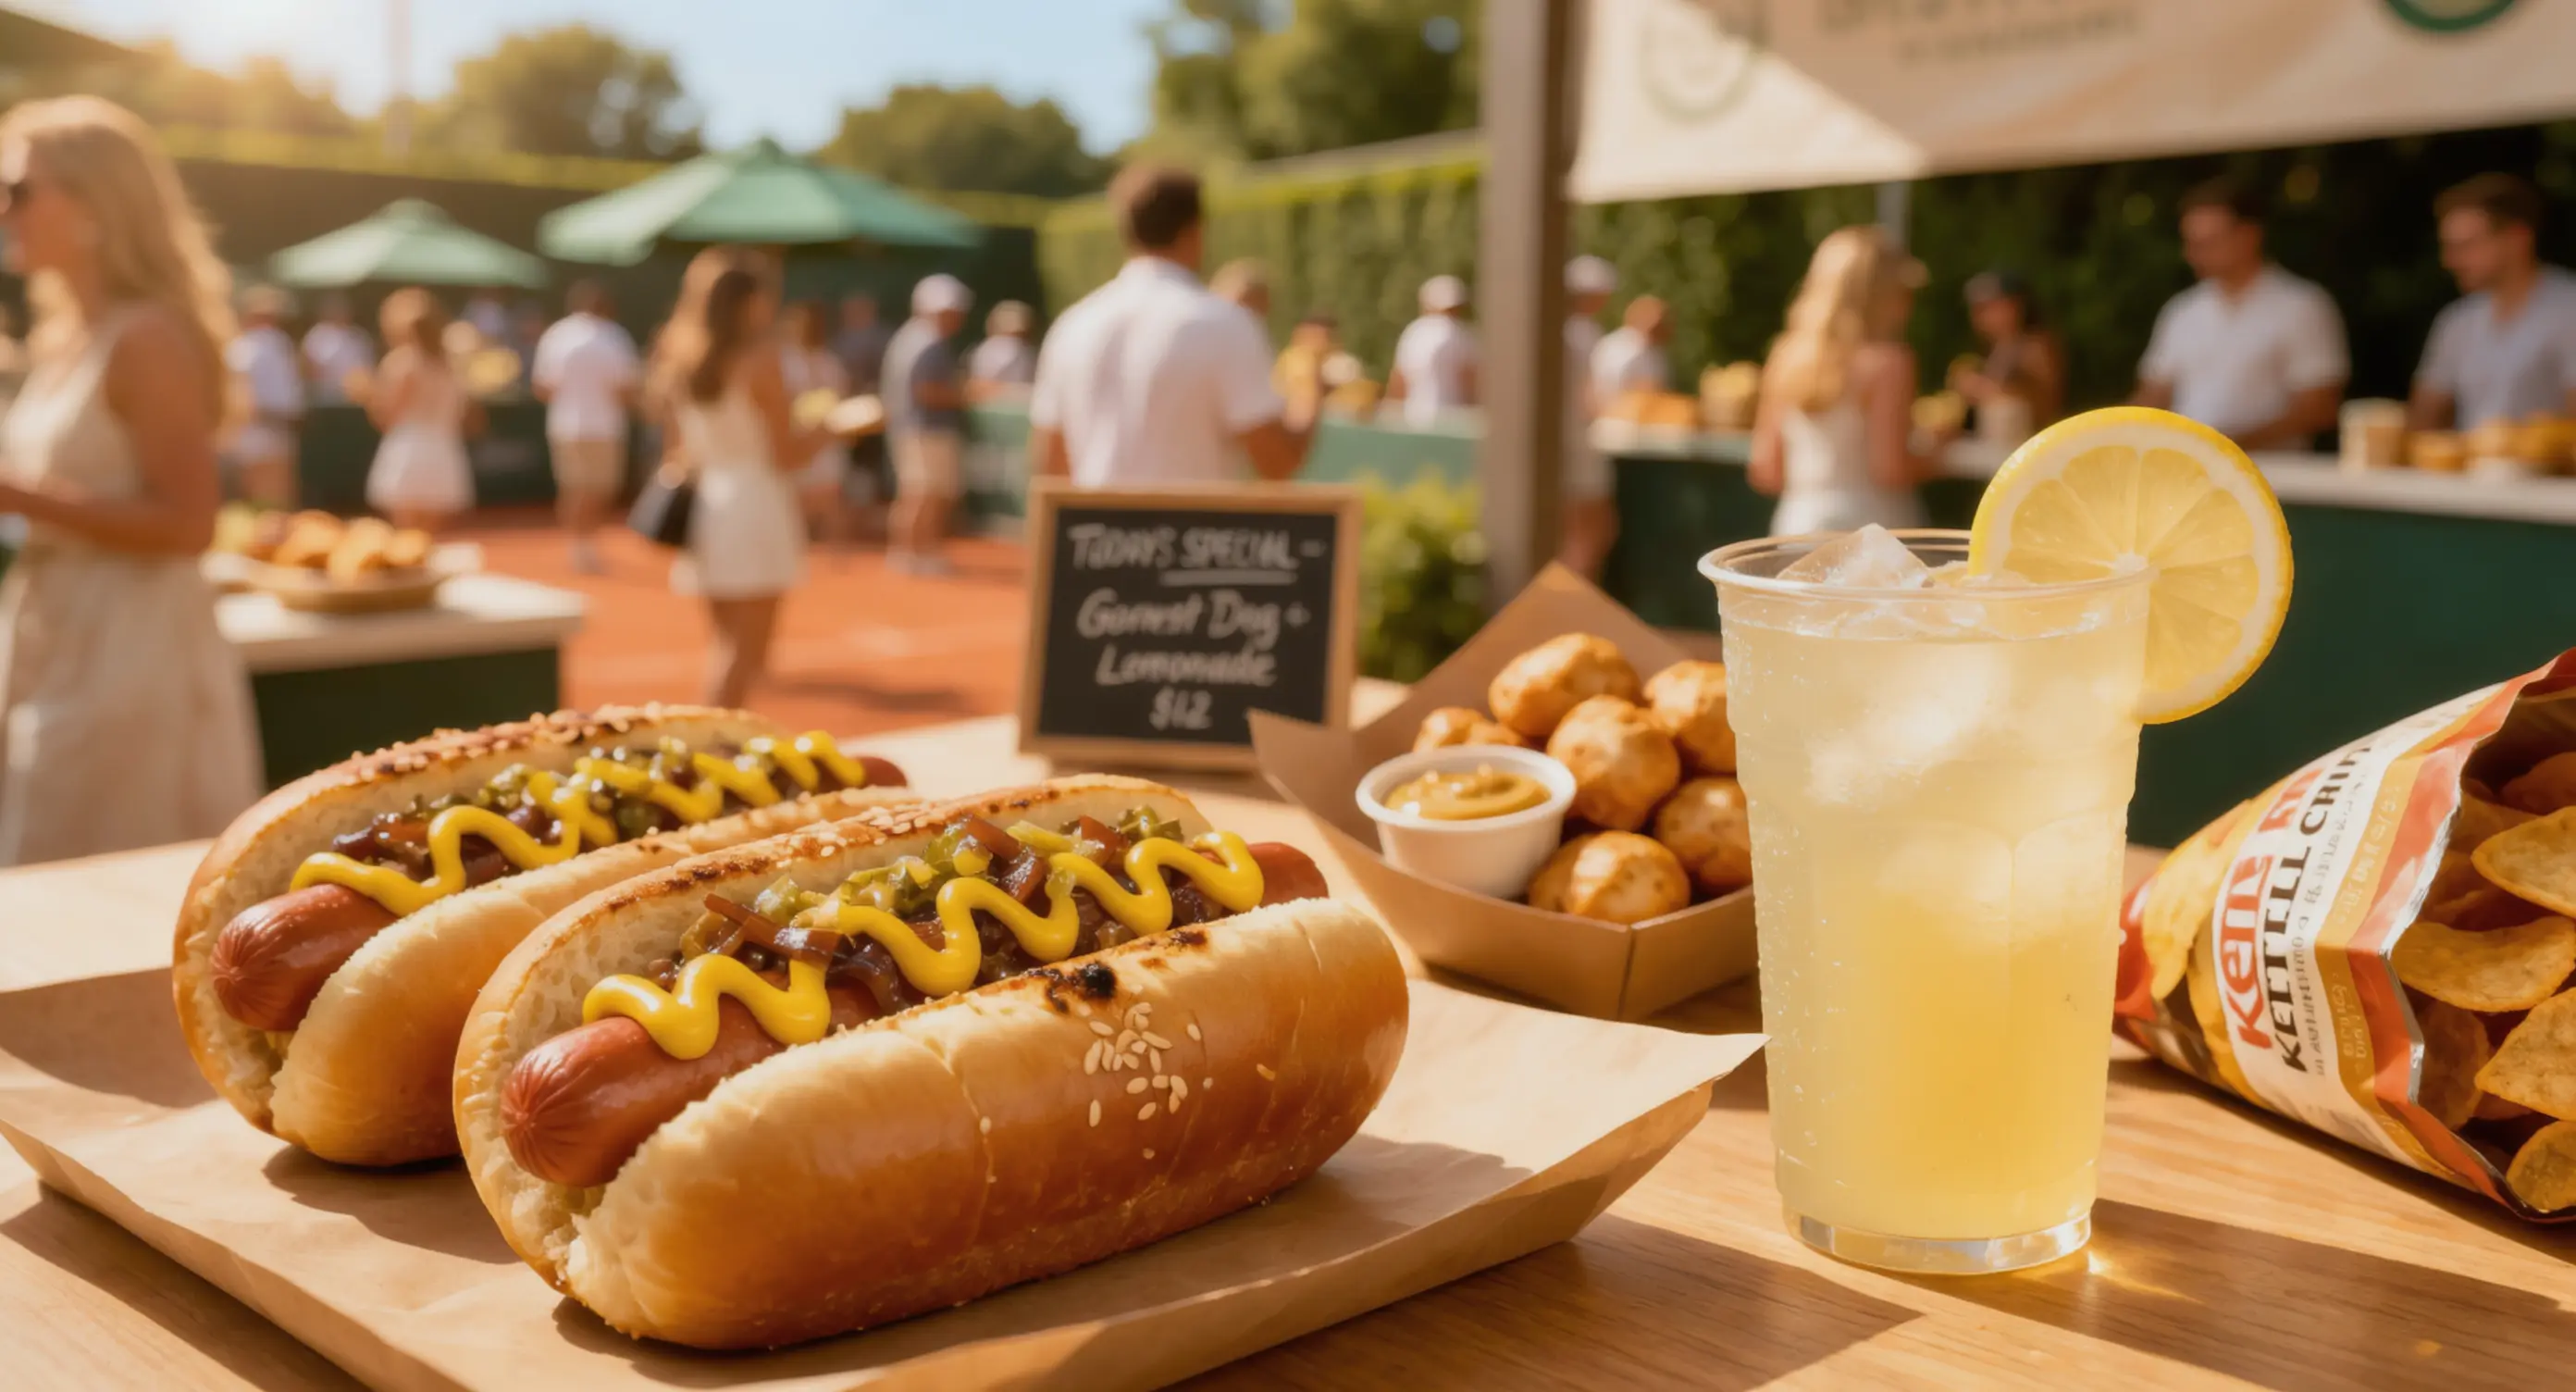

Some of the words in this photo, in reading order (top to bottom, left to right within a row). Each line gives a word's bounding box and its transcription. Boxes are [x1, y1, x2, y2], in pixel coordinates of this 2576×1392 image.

[1180, 526, 1300, 570] SPECIAL
[1207, 589, 1281, 650] Dog
[1148, 686, 1213, 731] $12
